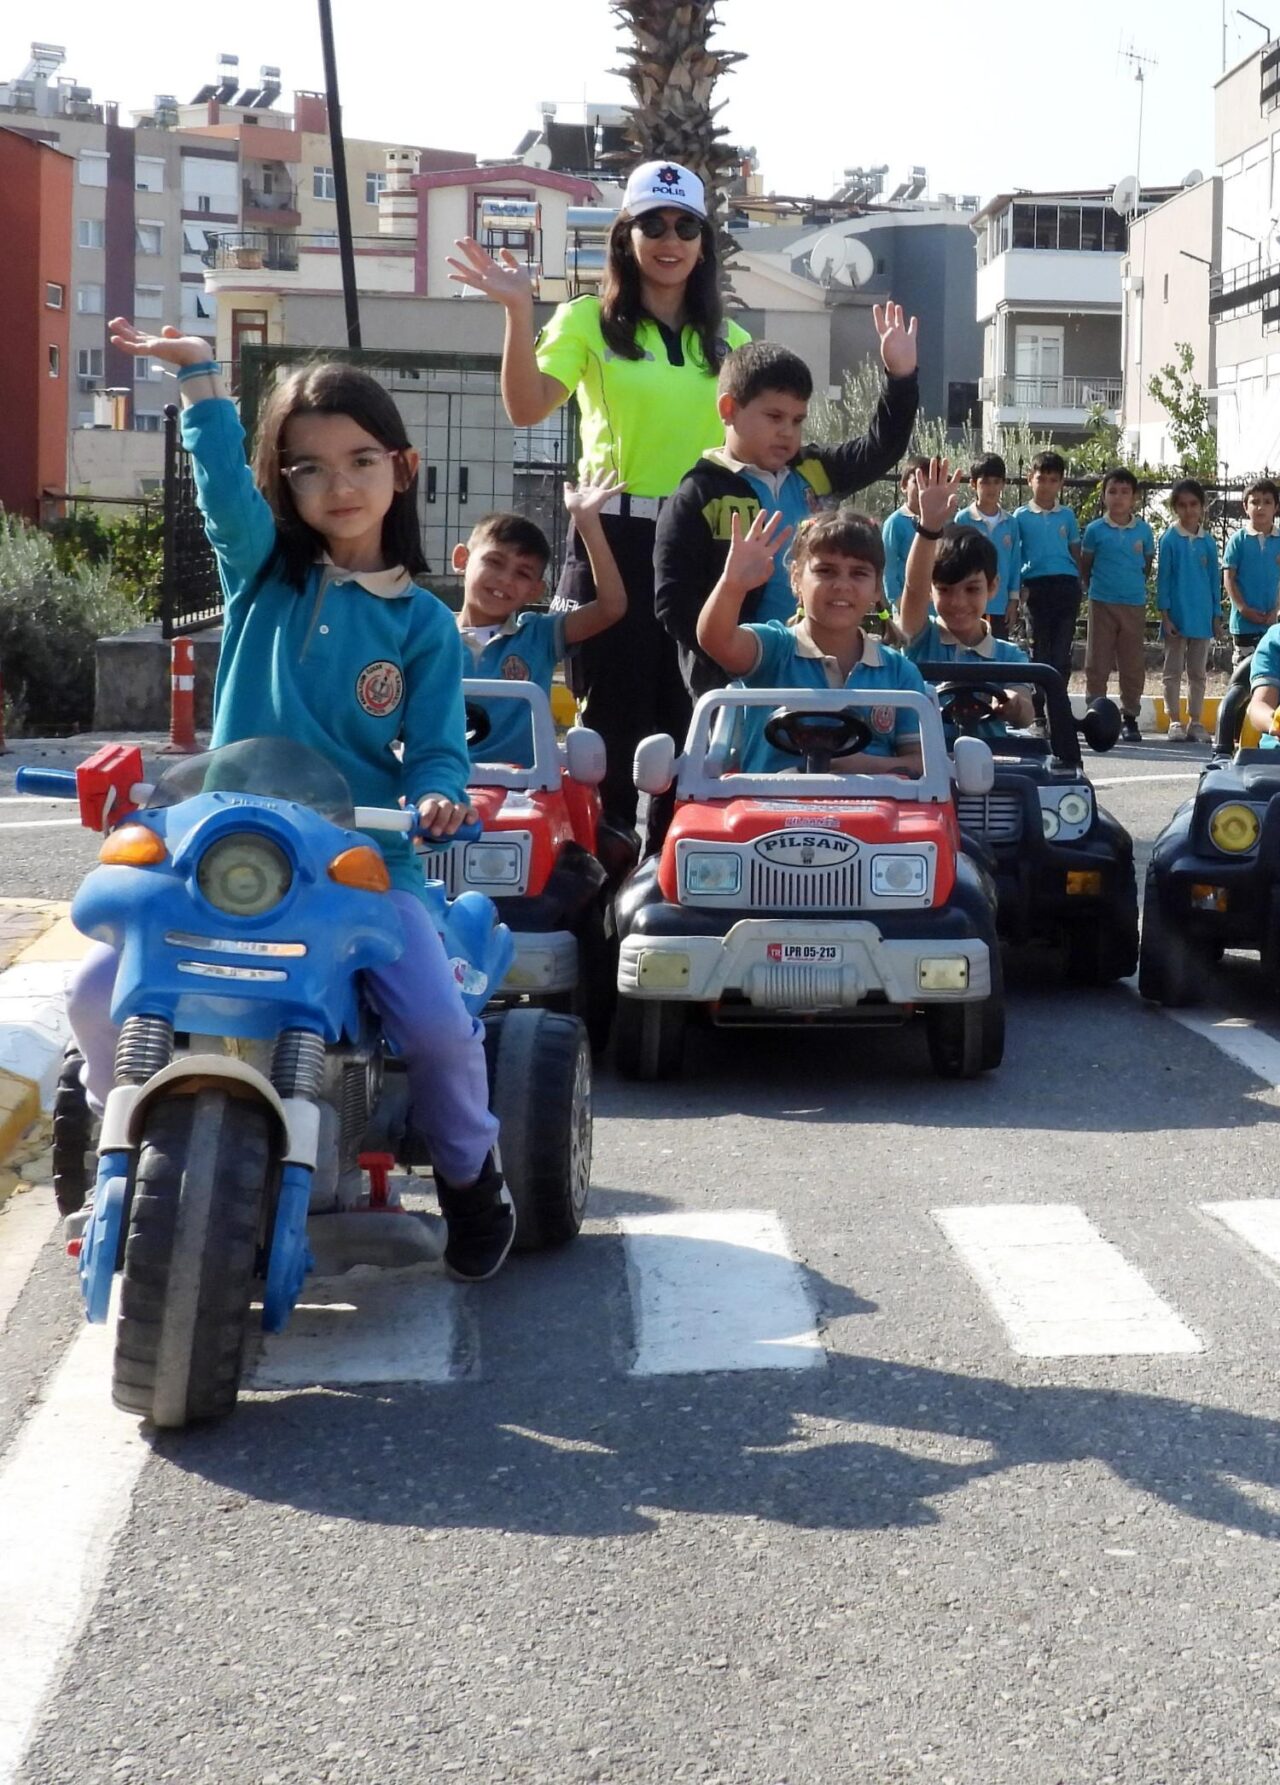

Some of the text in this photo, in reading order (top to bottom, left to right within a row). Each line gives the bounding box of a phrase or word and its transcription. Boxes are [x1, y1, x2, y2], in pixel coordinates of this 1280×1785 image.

[764, 835, 850, 853] PİLSAN
[784, 945, 837, 958] LPR 05-213
